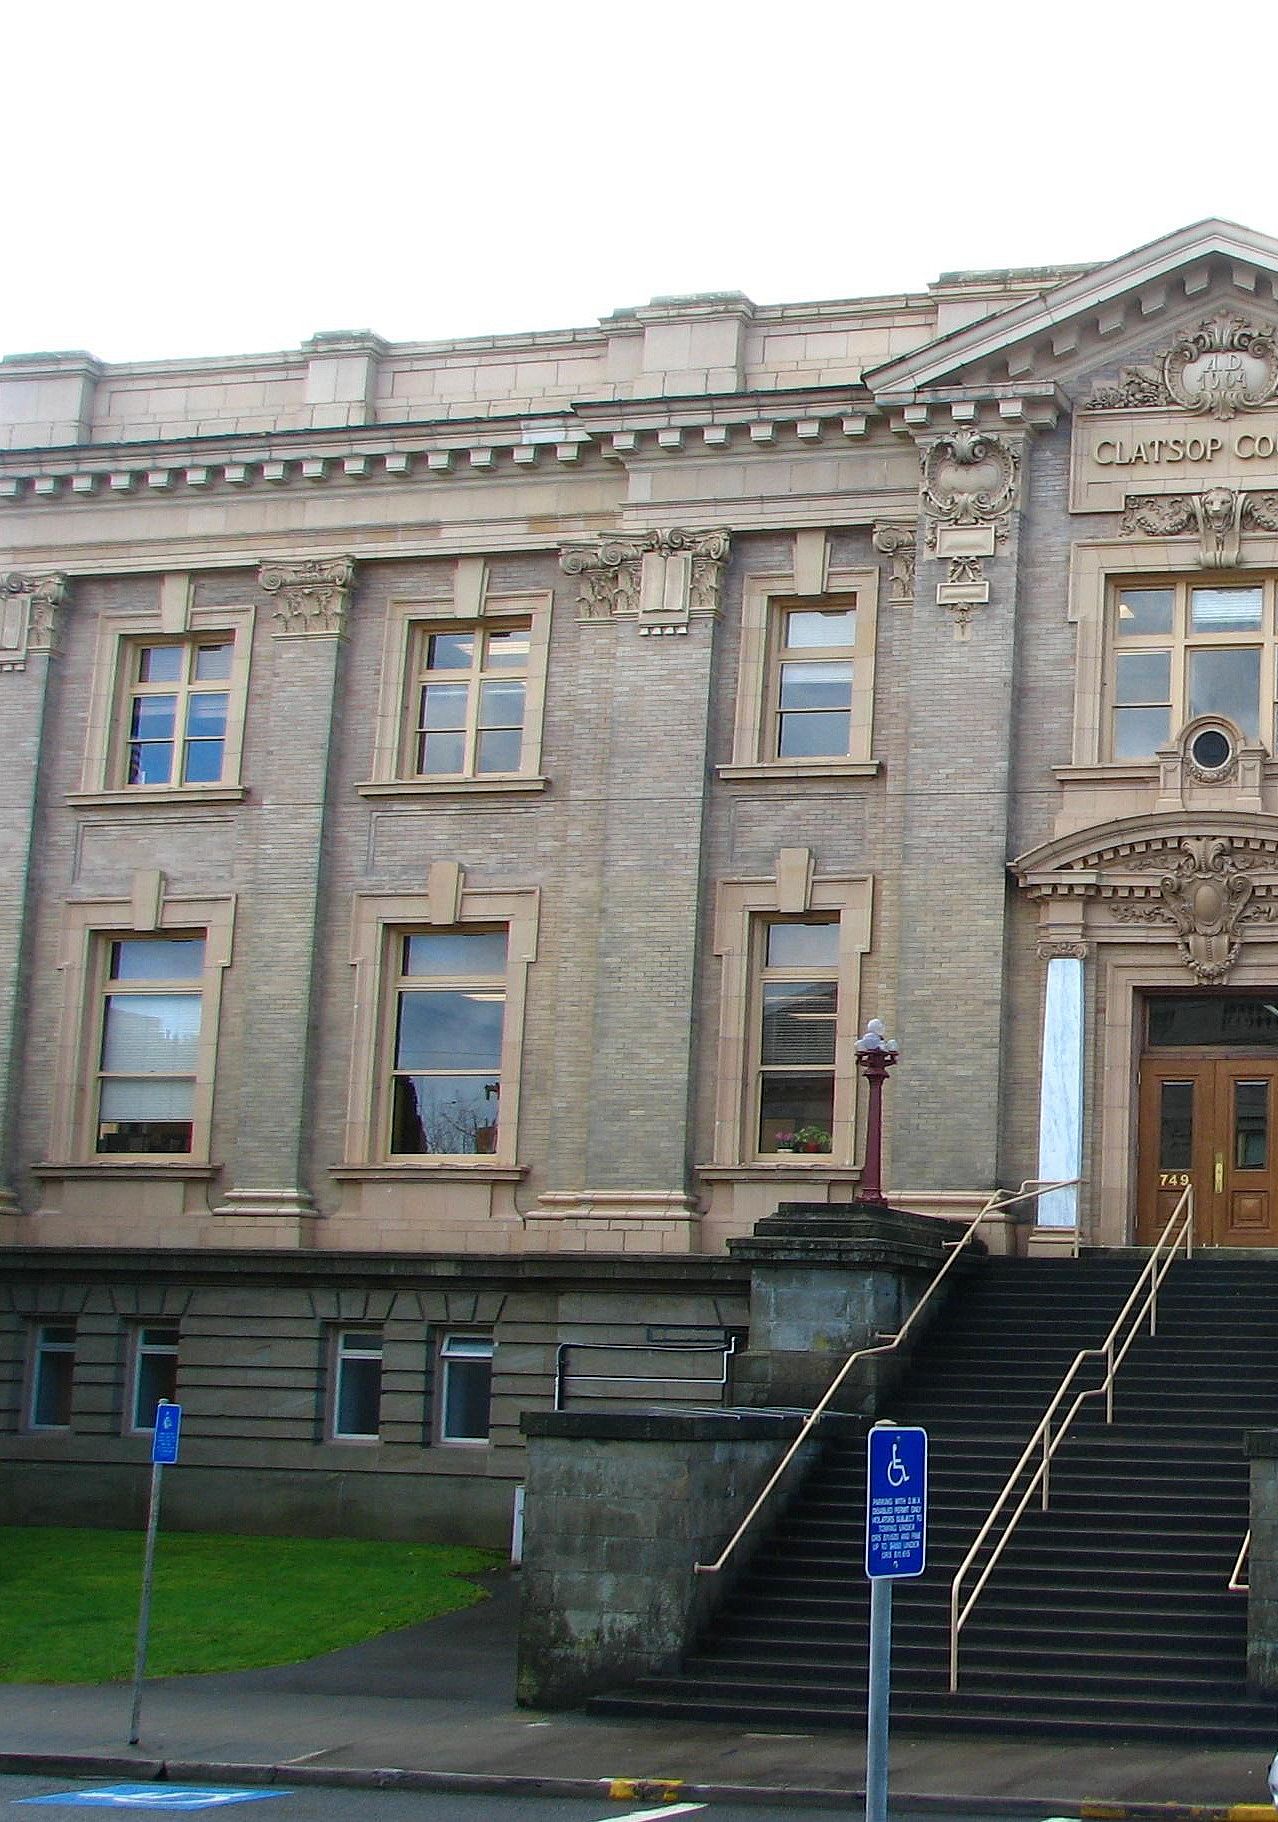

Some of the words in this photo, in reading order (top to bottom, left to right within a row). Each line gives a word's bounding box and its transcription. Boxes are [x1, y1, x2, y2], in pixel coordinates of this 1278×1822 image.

[1197, 371, 1248, 391] 1904
[1094, 437, 1222, 465] CLATSOP
[1160, 1174, 1190, 1186] 749
[917, 1514, 922, 1522] TO
